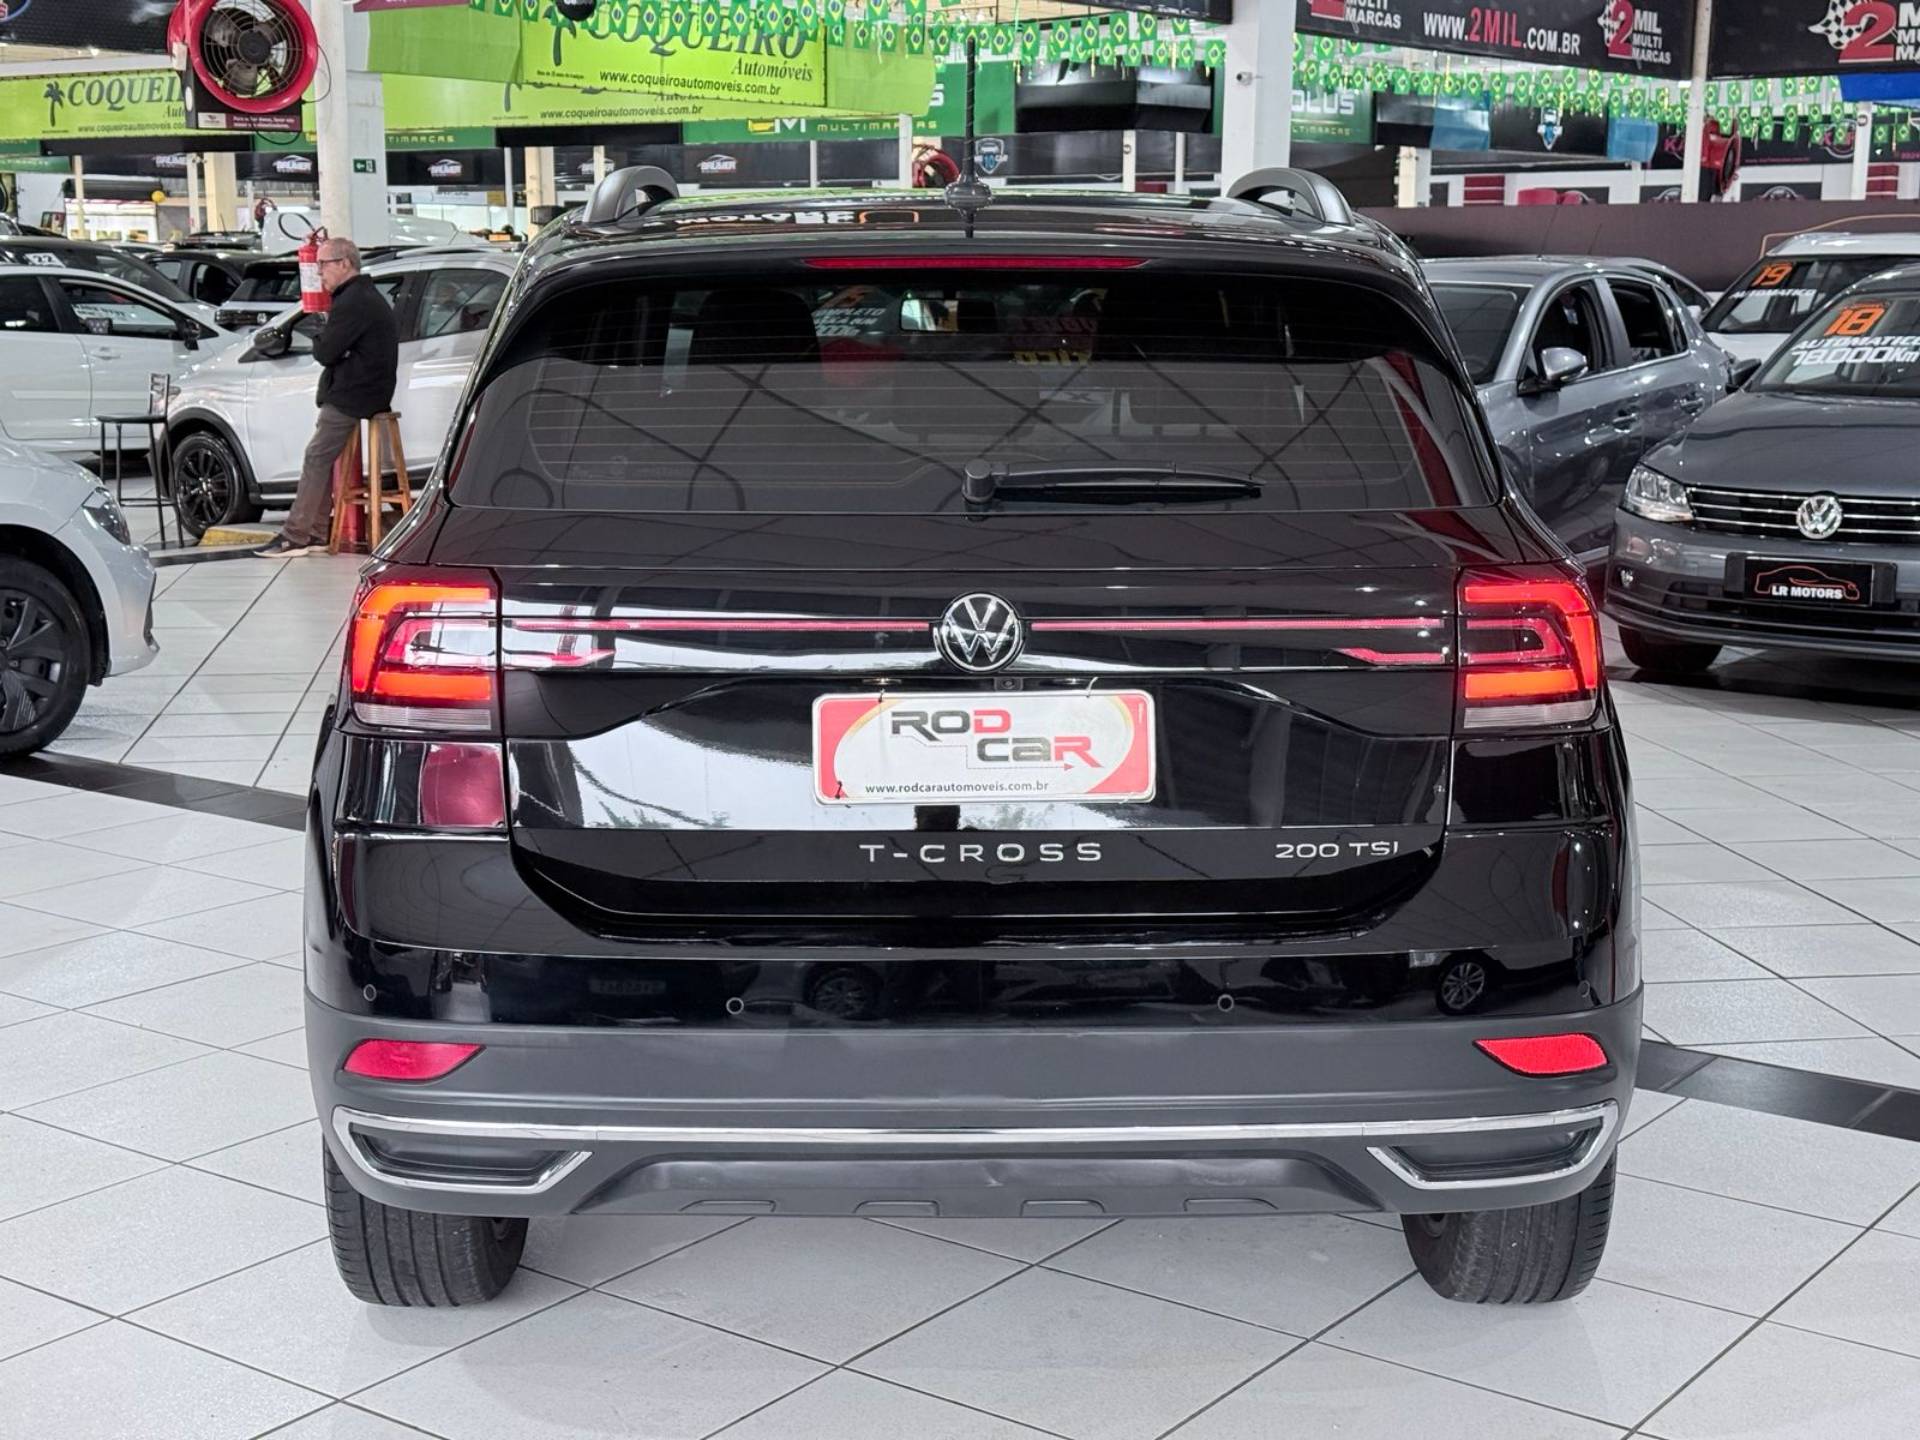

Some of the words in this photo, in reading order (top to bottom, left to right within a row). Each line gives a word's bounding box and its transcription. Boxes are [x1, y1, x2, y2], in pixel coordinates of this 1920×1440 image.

[1345, 7, 1402, 29] MARCAS
[1634, 9, 1662, 35] MIL
[1423, 7, 1581, 56] WWW.2MIL.COM.BR
[1633, 33, 1662, 49] MULTI
[1632, 47, 1672, 65] MARCAS
[731, 57, 813, 82] Automóveis
[600, 71, 781, 96] www.coqueiroautomoveis.com.br
[540, 104, 703, 119] www.coqueiroautomoveis.com.br
[816, 121, 938, 132] MULTIMARAS
[1751, 263, 1792, 287] 19
[1824, 304, 1886, 336] 18
[1771, 585, 1788, 596] LR
[1790, 586, 1843, 600] MOTORS
[891, 709, 1012, 742] ROD
[865, 781, 1049, 795] www.rodcarautomoveis.com.br
[859, 843, 1102, 863] T-CROSS
[1275, 843, 1339, 858] 200
[1348, 841, 1399, 857] TSI
